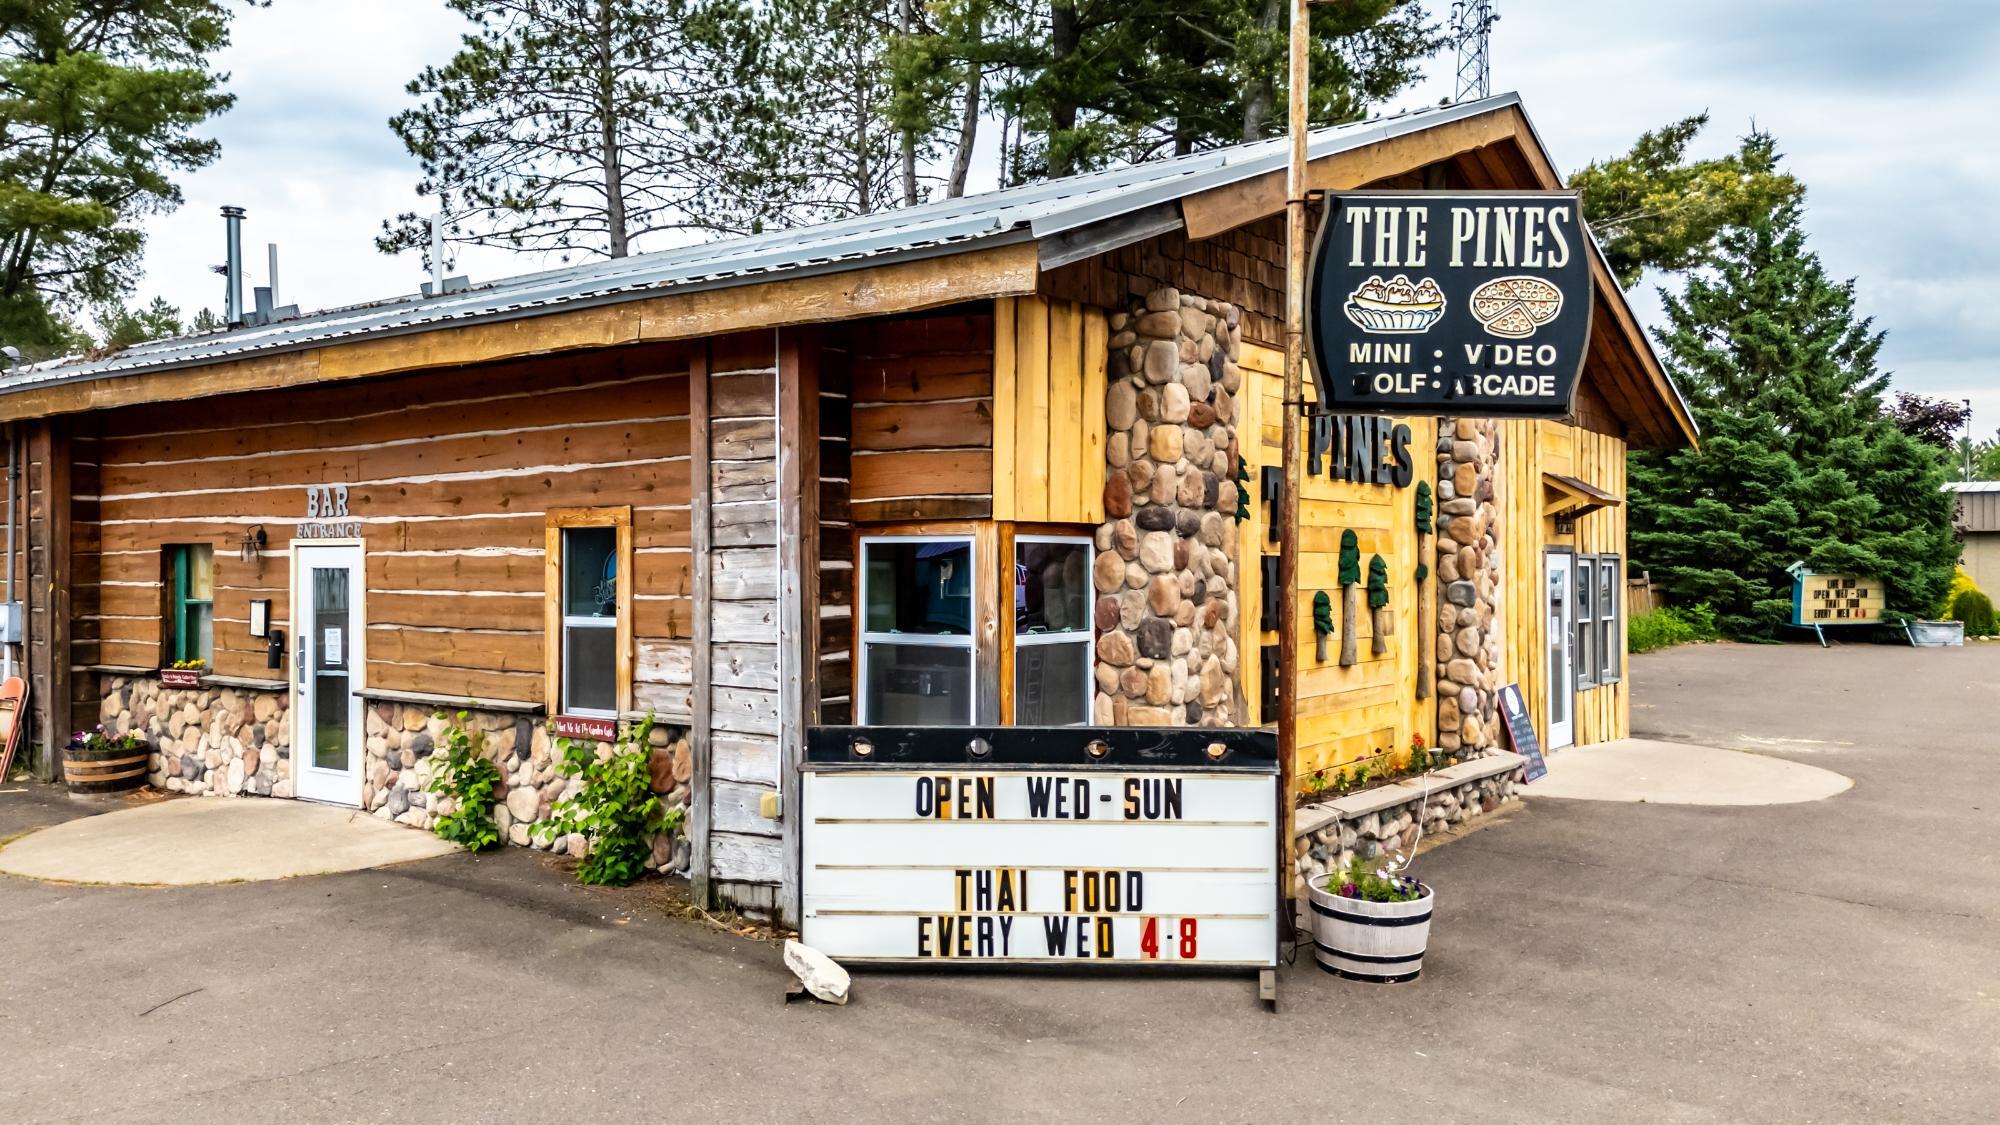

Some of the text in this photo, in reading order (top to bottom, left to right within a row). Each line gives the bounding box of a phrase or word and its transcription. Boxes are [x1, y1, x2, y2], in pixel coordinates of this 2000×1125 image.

[1346, 206, 1570, 268] THE PINES
[1350, 342, 1411, 364] MINI
[1464, 343, 1557, 367] VDEO
[1353, 372, 1427, 395] OLF
[1307, 416, 1413, 488] PINES
[307, 483, 350, 518] BAR
[296, 522, 362, 538] ENTRANCE
[915, 776, 995, 819] OPEN
[955, 869, 1143, 912] THAI FOOD
[918, 915, 1198, 959] EVERY WED 4-8
